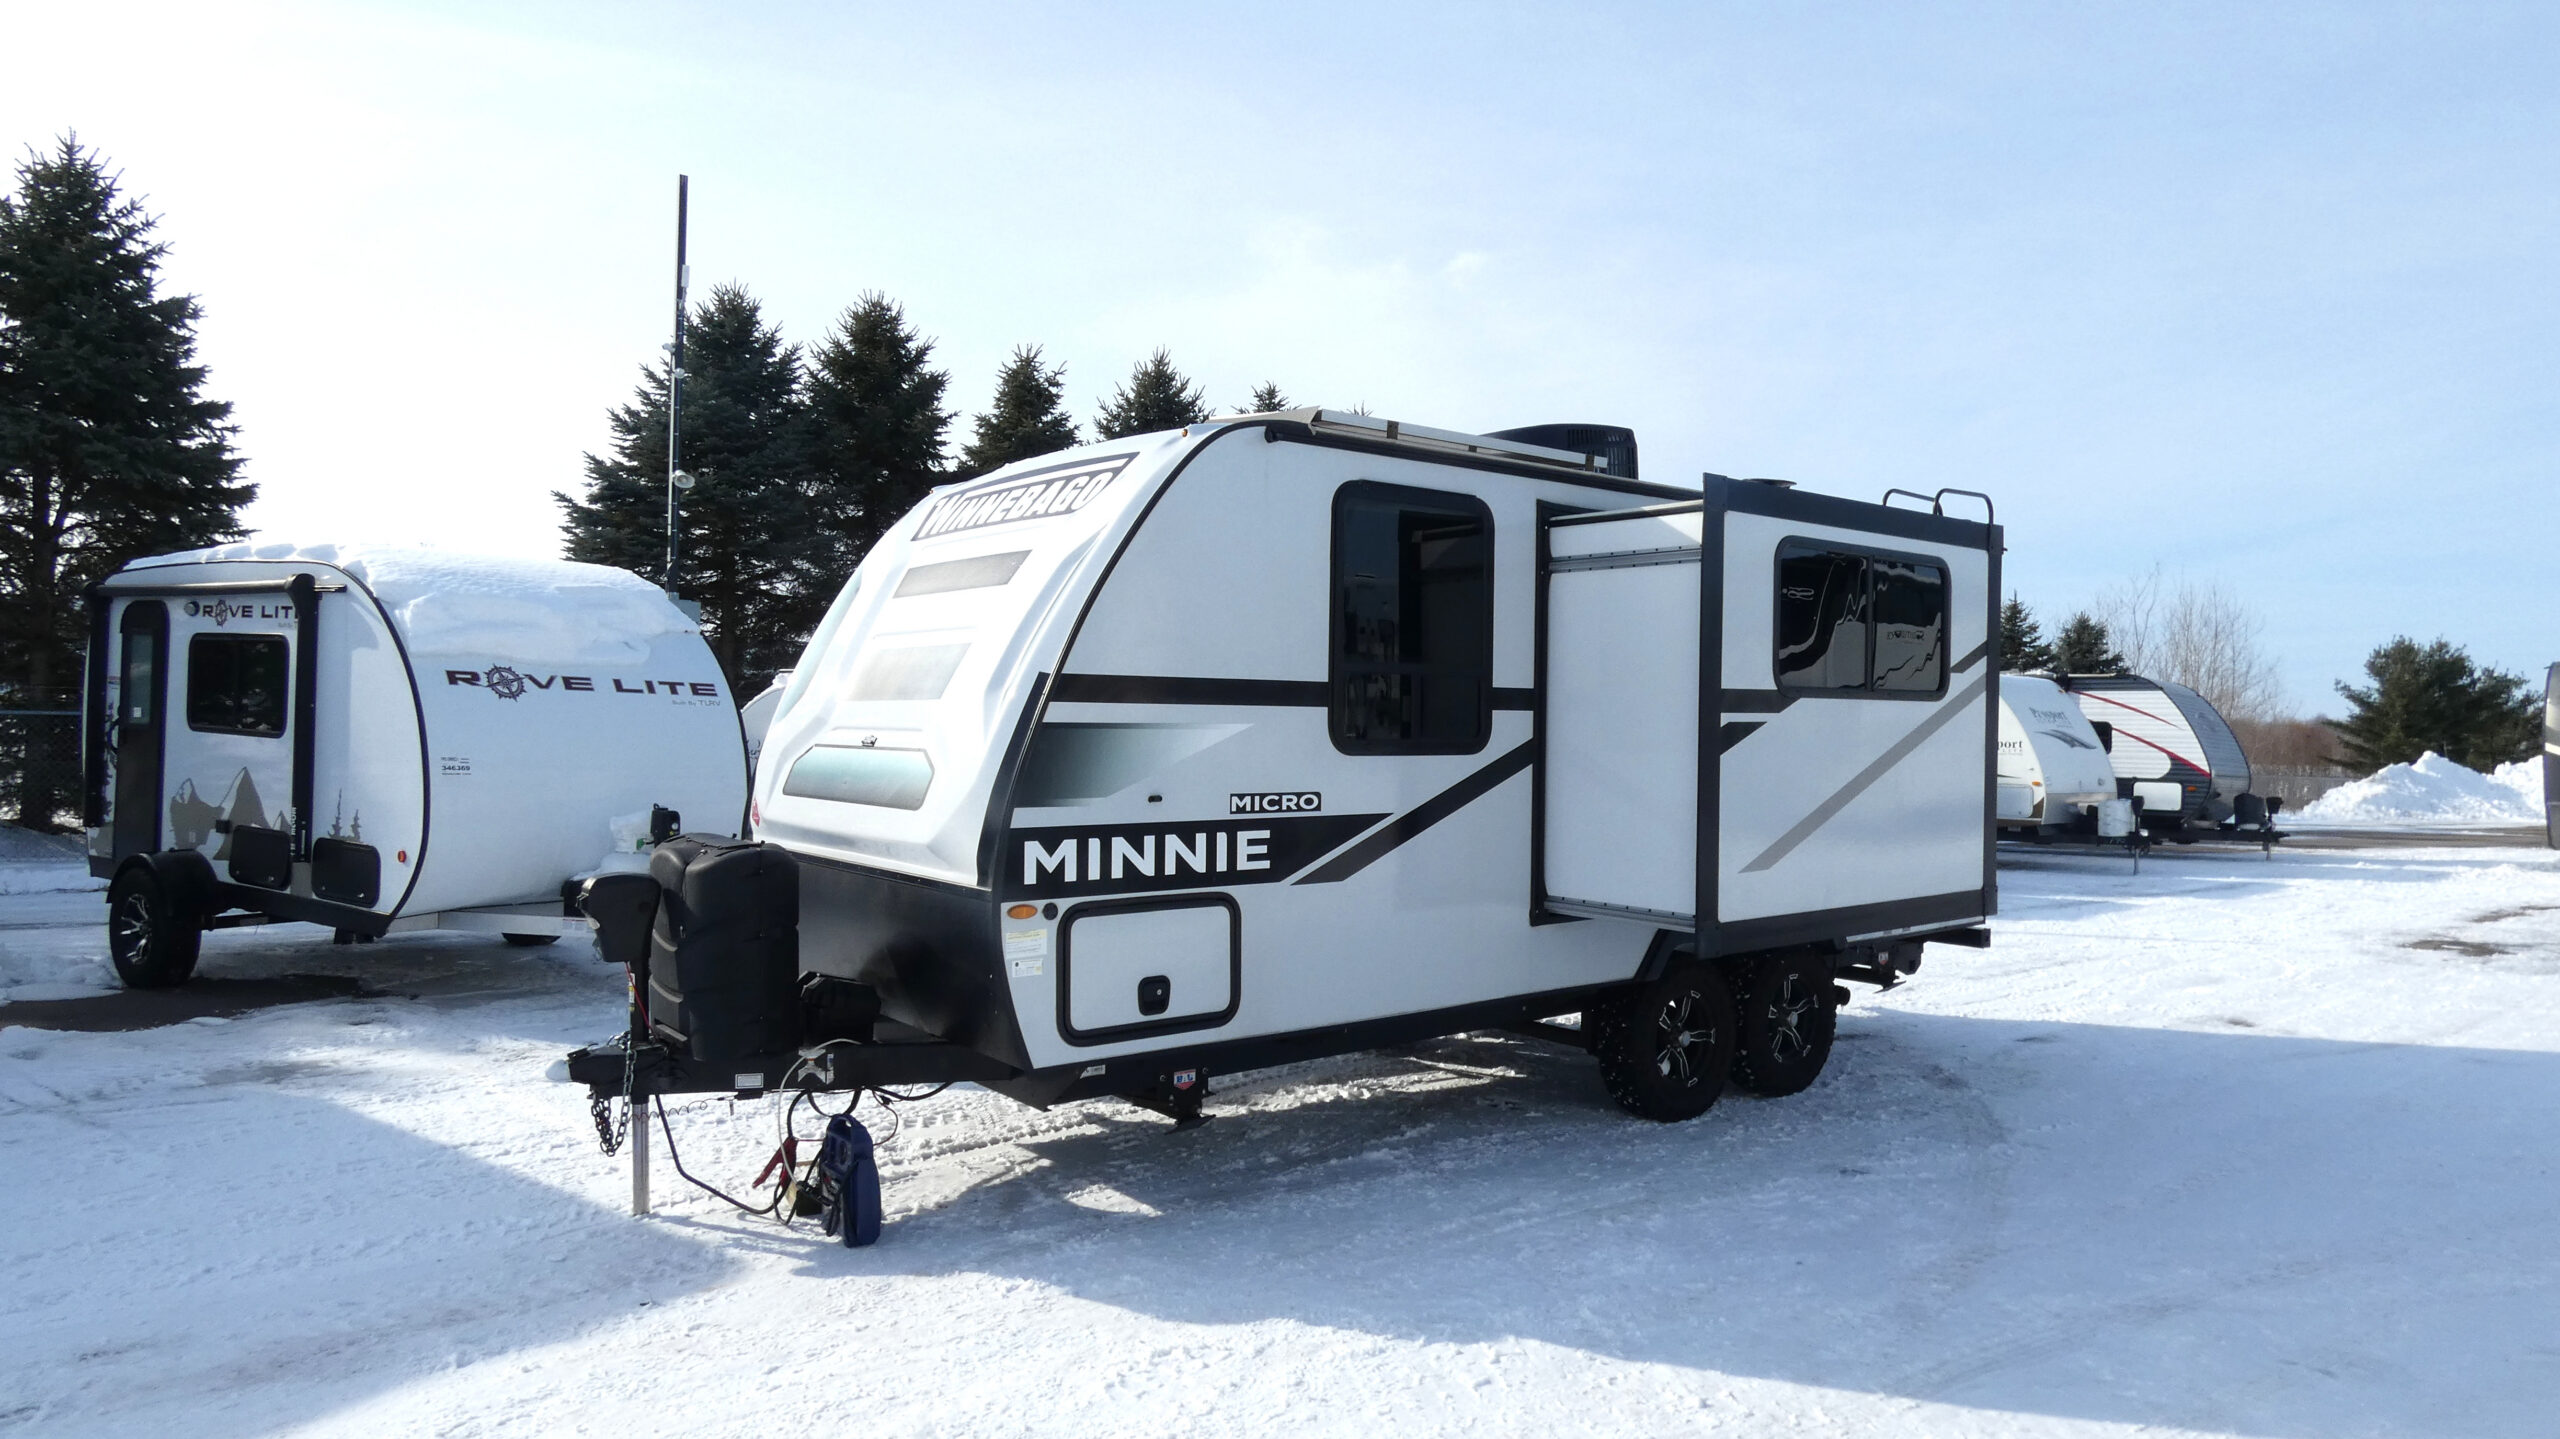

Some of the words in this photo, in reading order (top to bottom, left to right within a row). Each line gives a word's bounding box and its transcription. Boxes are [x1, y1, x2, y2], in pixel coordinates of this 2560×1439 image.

[917, 471, 1114, 539] WINNEBAGO
[261, 605, 298, 620] LIT
[612, 678, 718, 697] LITE
[1231, 793, 1319, 812] MICRO
[1023, 829, 1271, 886] MINNIE
